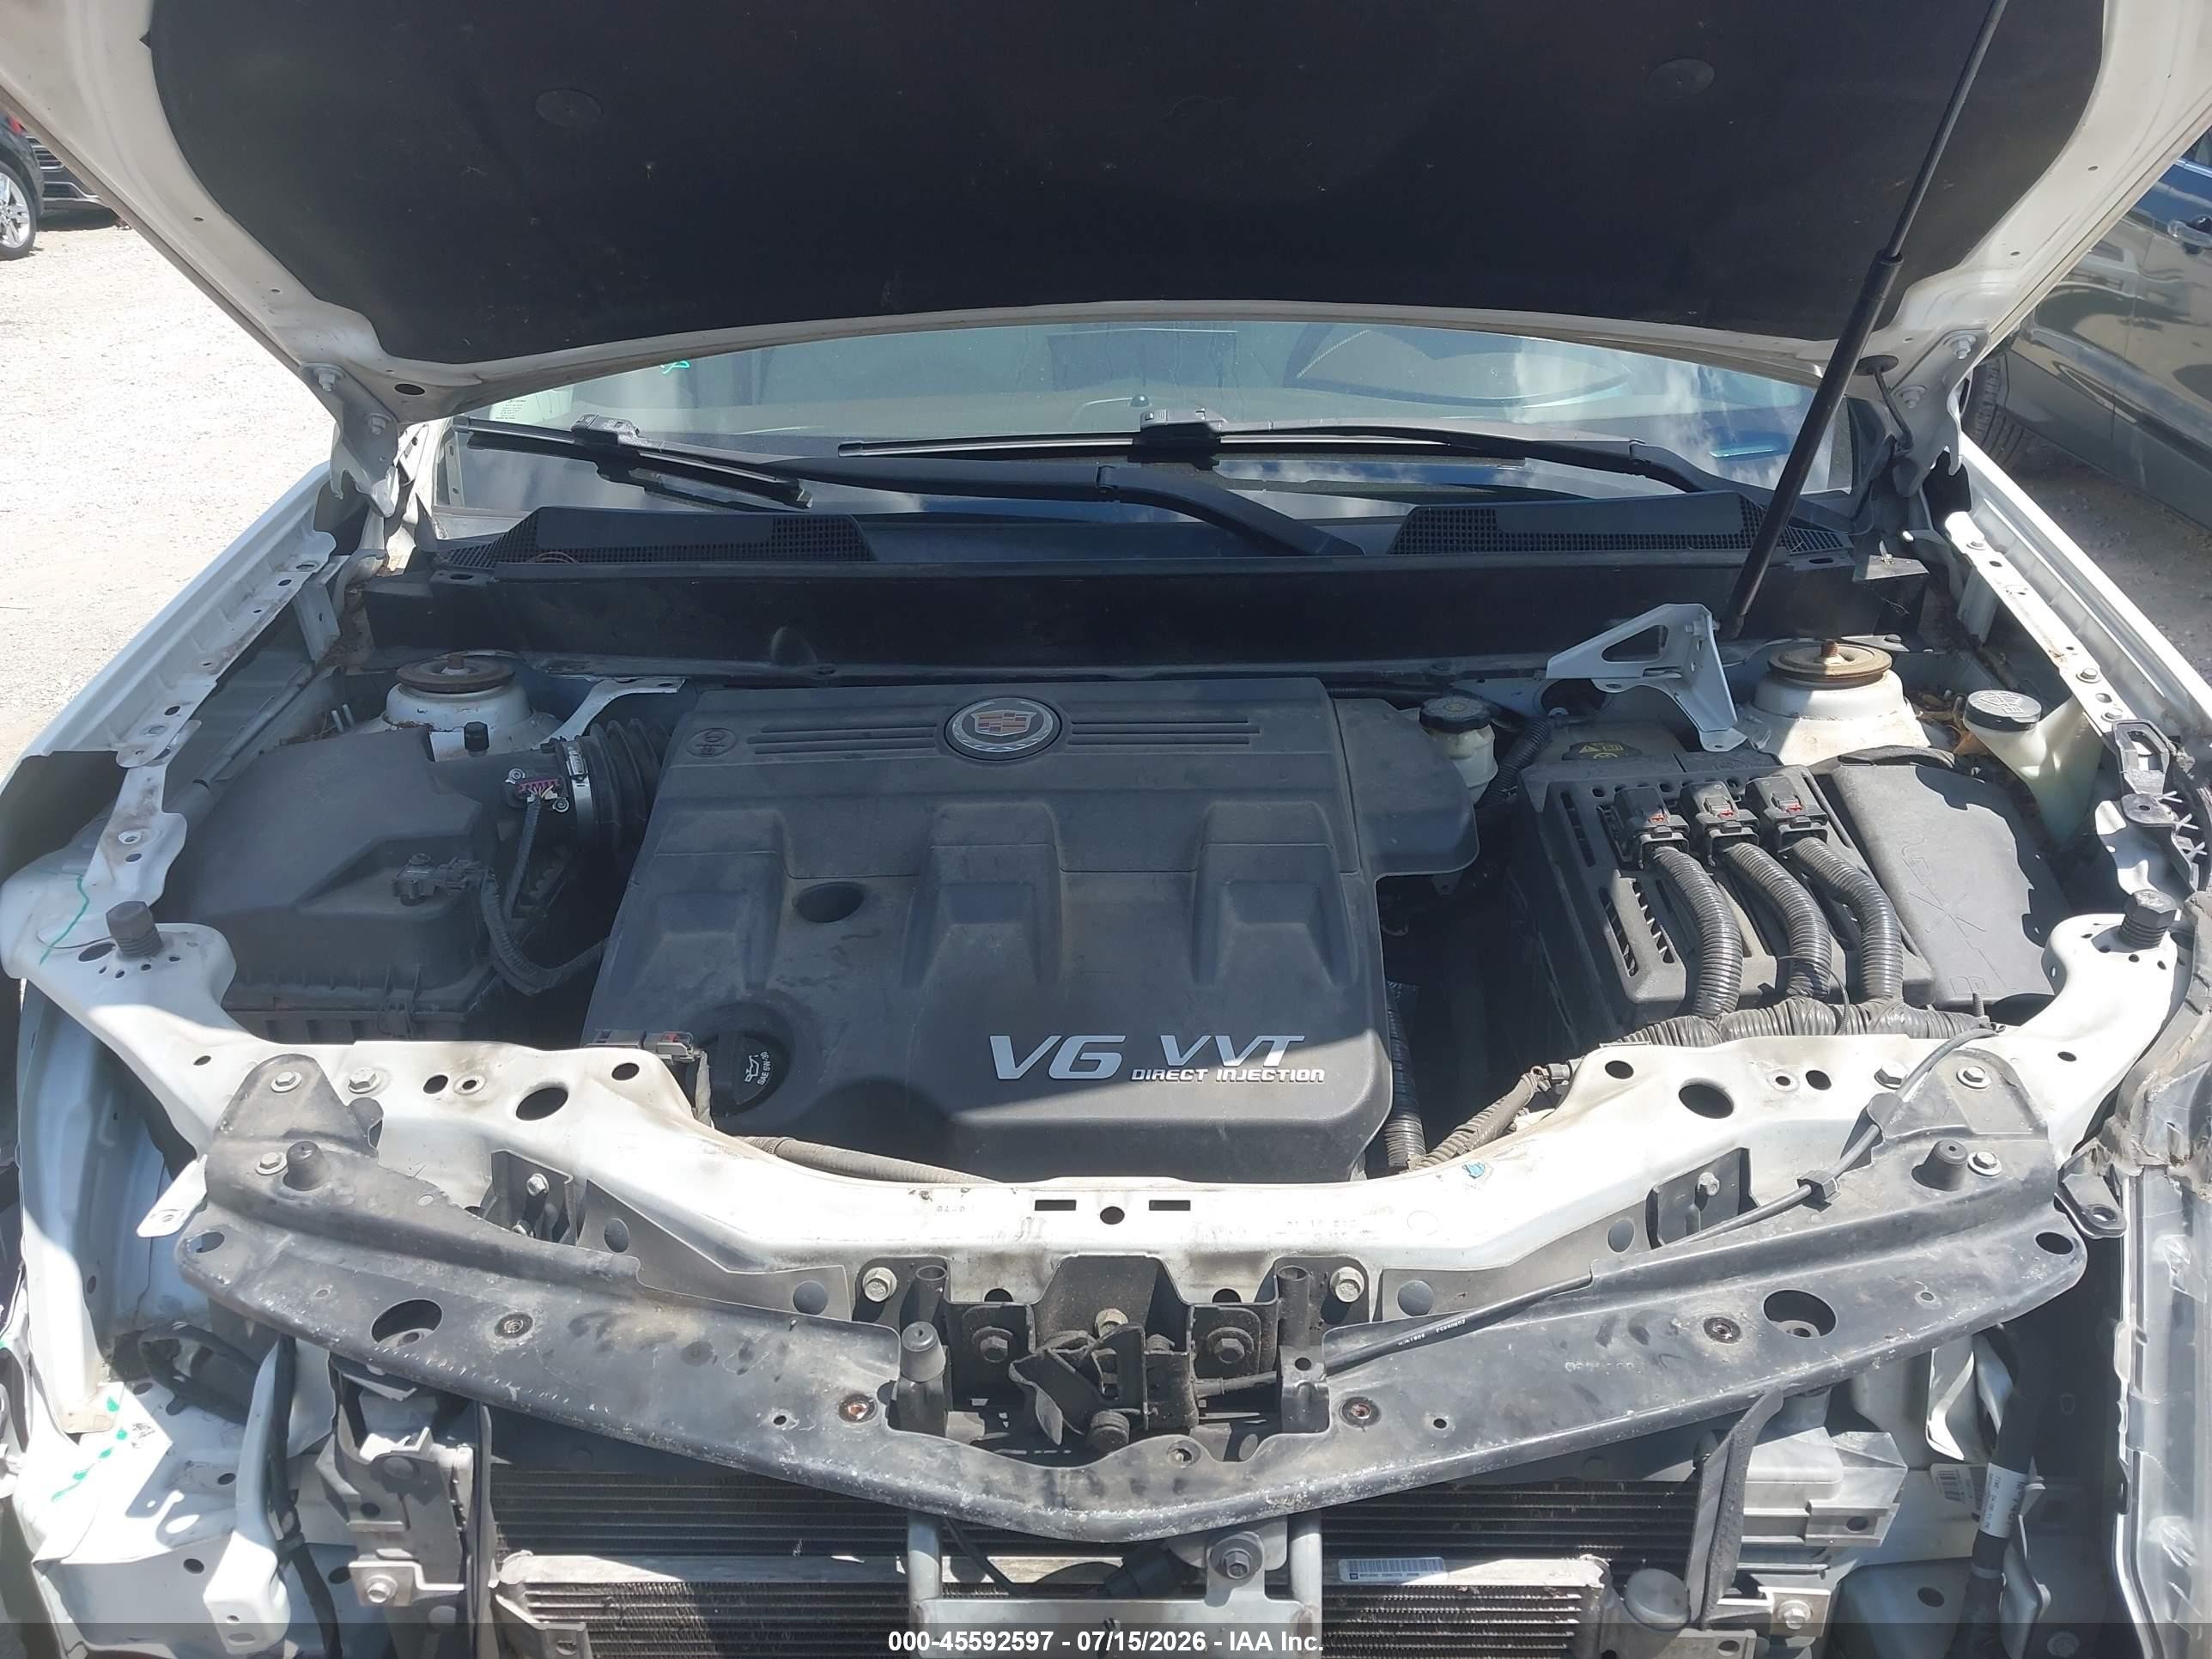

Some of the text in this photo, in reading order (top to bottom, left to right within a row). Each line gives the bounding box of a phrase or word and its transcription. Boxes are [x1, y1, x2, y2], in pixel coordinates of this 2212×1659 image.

[988, 1034, 1306, 1080] V6 VVT
[757, 1072, 769, 1085] SAE
[1130, 1068, 1326, 1084] DIRECT INJECTION
